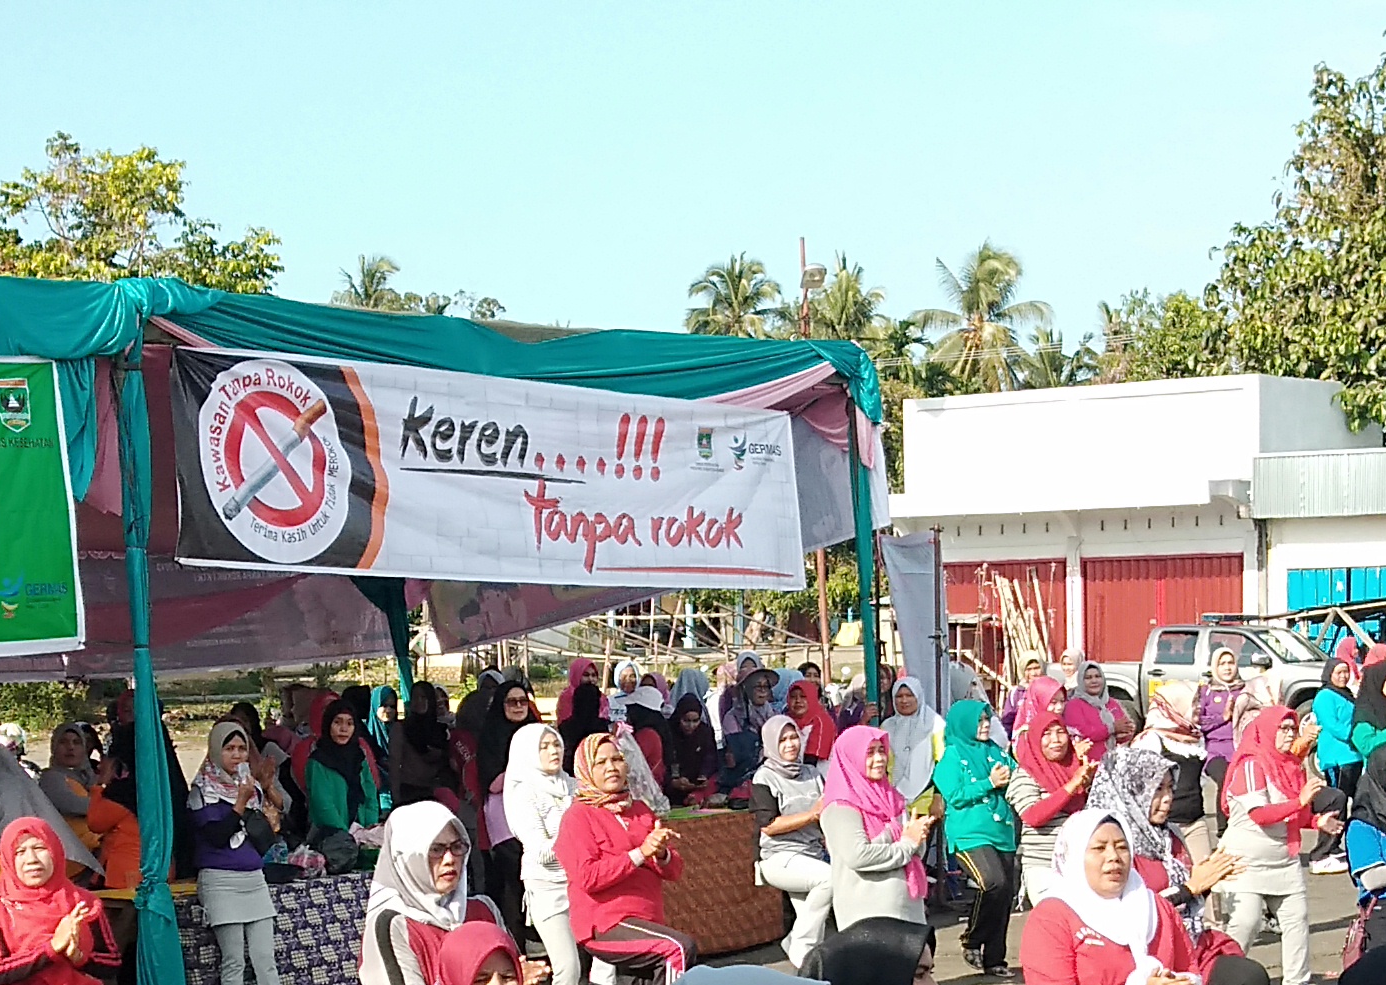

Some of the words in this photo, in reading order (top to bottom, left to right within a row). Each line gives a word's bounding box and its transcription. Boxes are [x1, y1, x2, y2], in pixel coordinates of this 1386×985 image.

[209, 401, 231, 493] Kawasan
[265, 367, 311, 408] Rokok
[748, 443, 782, 457] GERMAS
[250, 517, 278, 542] Terima
[281, 529, 307, 543] Kasih
